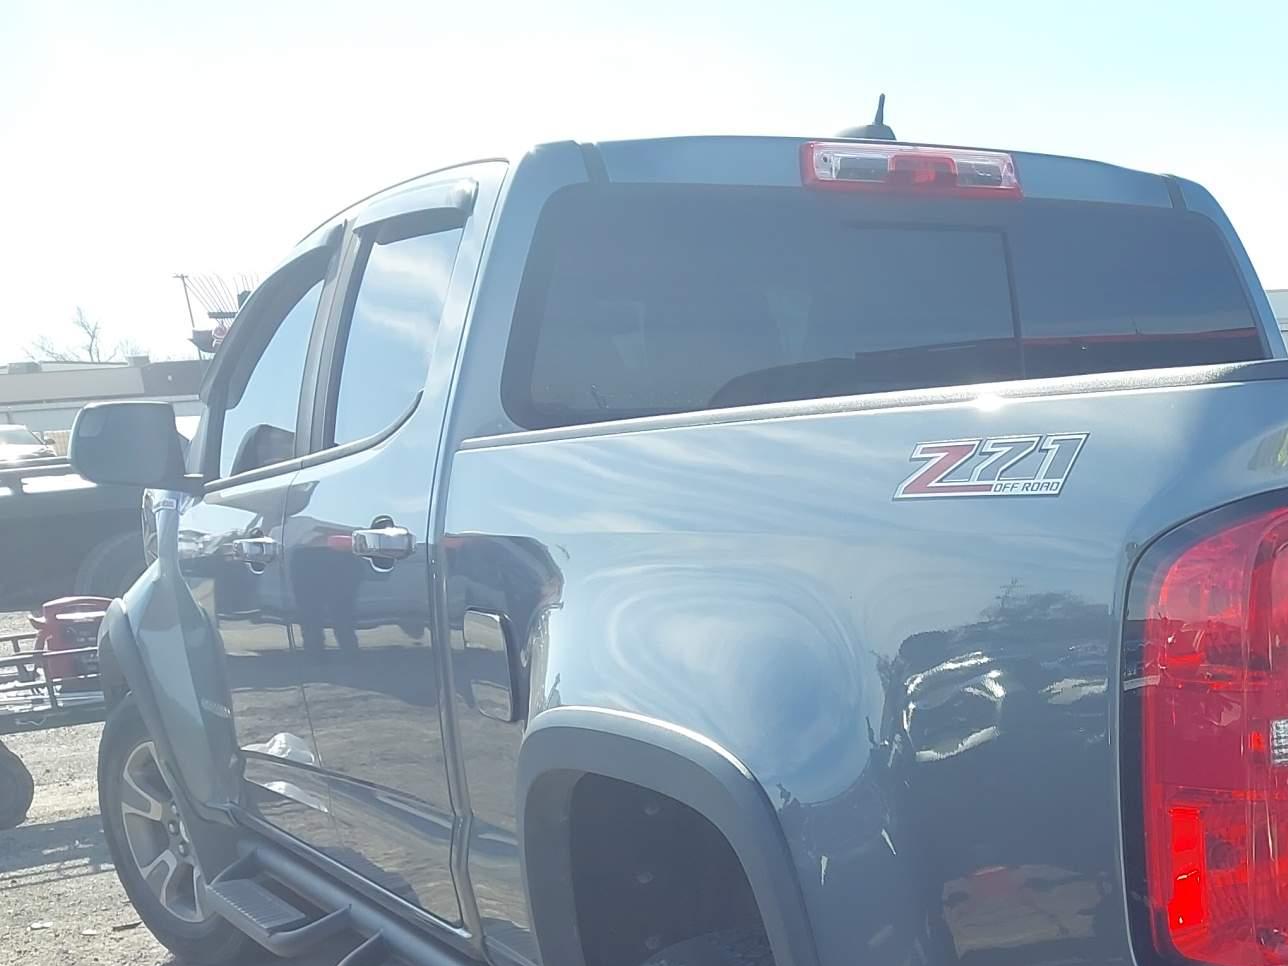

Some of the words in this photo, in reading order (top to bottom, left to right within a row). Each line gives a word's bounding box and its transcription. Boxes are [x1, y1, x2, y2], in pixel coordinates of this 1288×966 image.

[893, 433, 1089, 500] Z71
[993, 482, 1021, 493] OFF
[1022, 481, 1060, 492] ROAD
